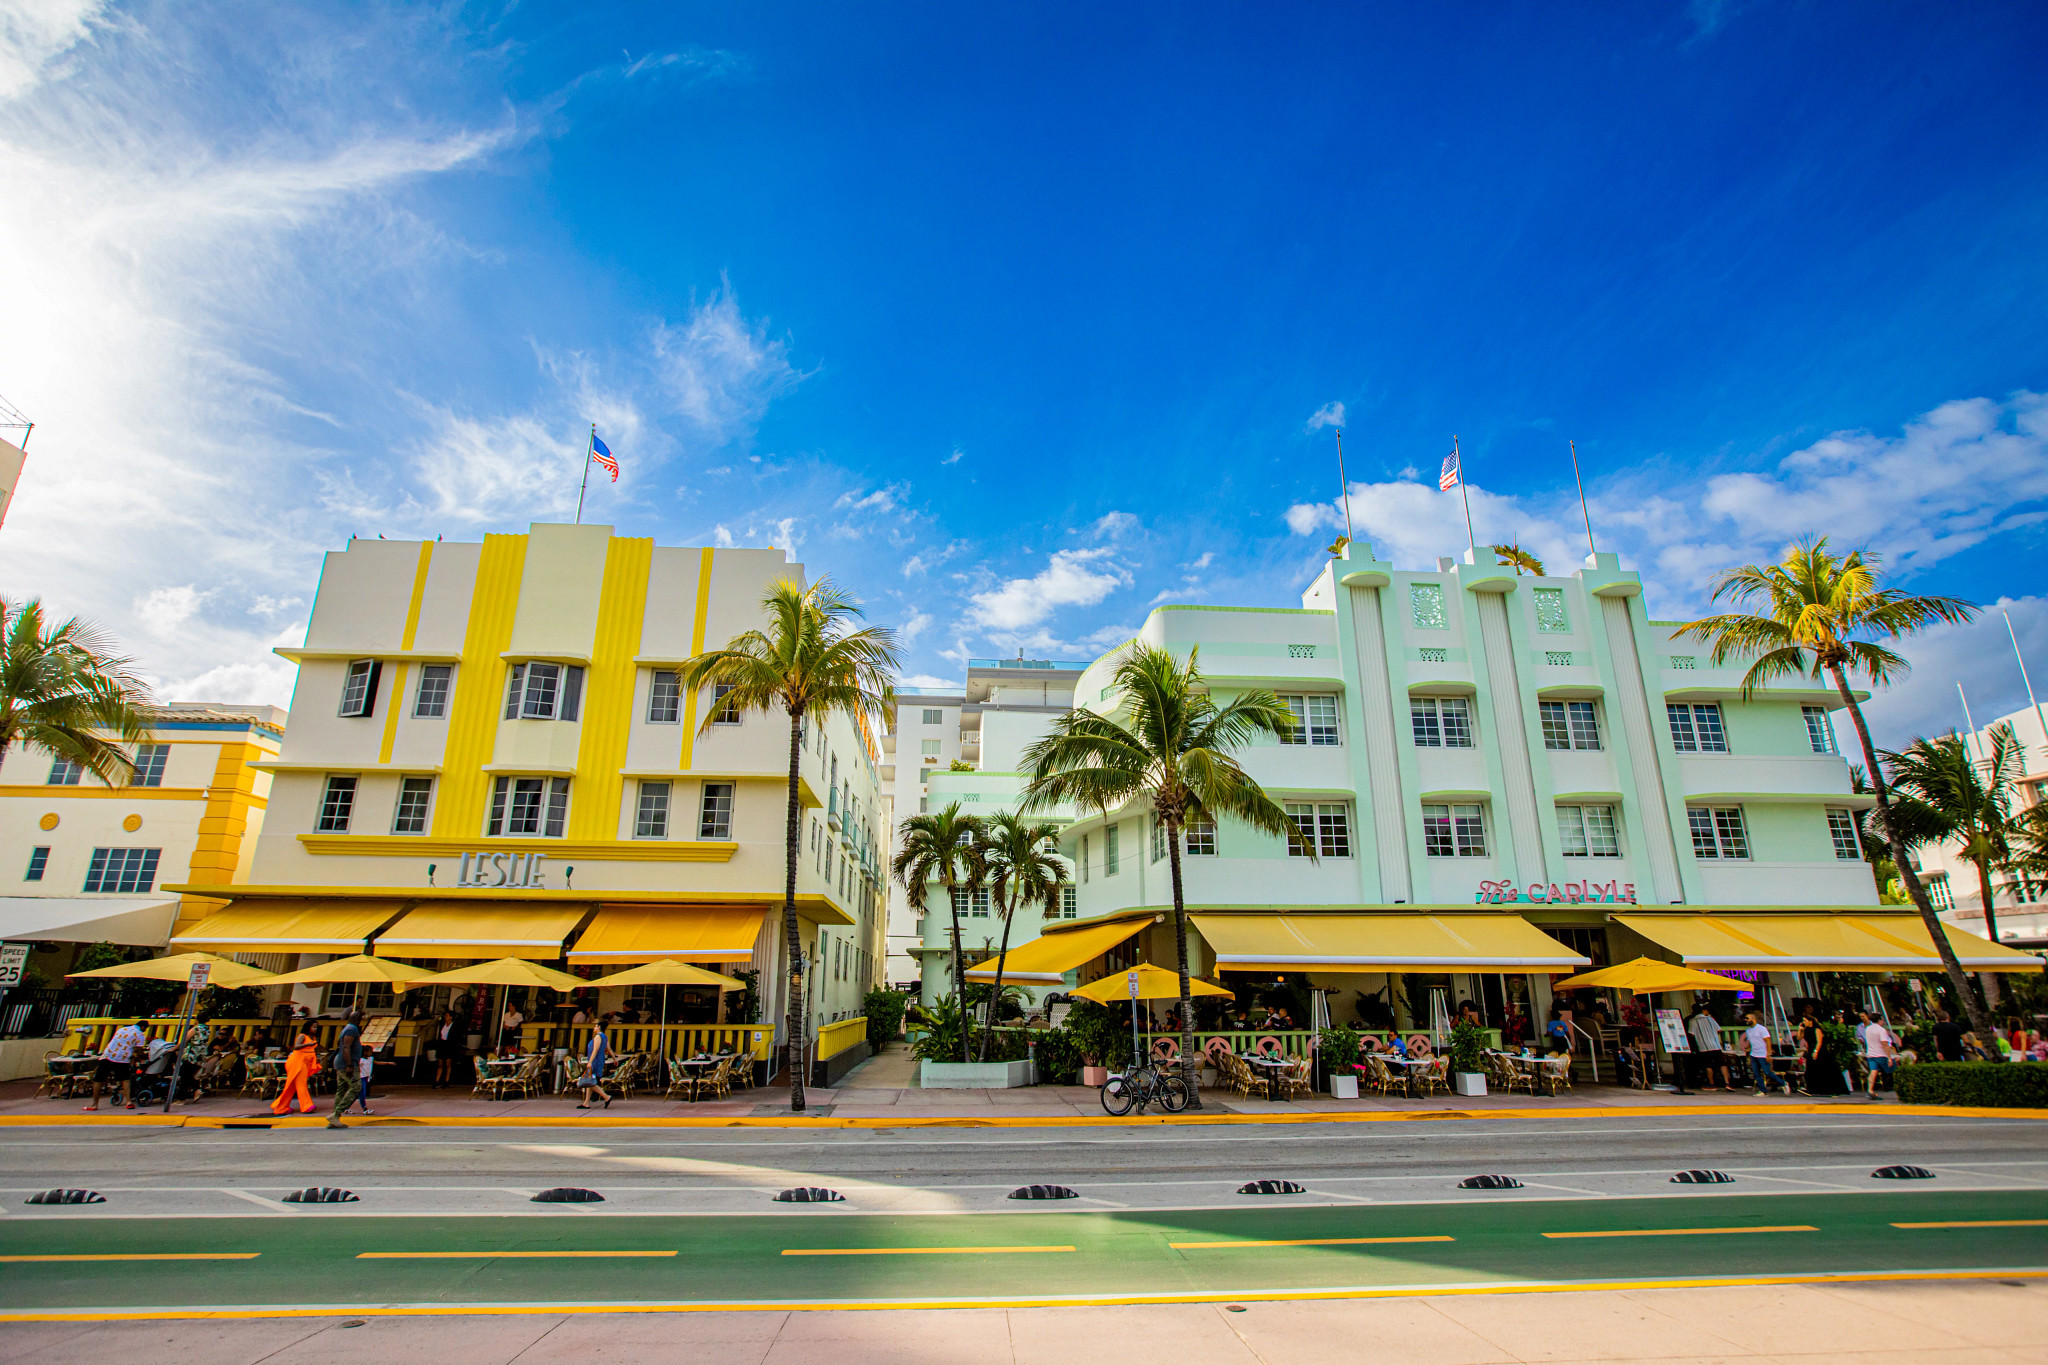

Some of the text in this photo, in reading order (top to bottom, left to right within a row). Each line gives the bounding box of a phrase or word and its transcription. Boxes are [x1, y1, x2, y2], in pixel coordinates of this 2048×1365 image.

[457, 852, 548, 888] LESLIE
[1479, 879, 1637, 903] The CARLYLE
[2, 948, 26, 956] SPEED
[0, 966, 20, 982] 25
